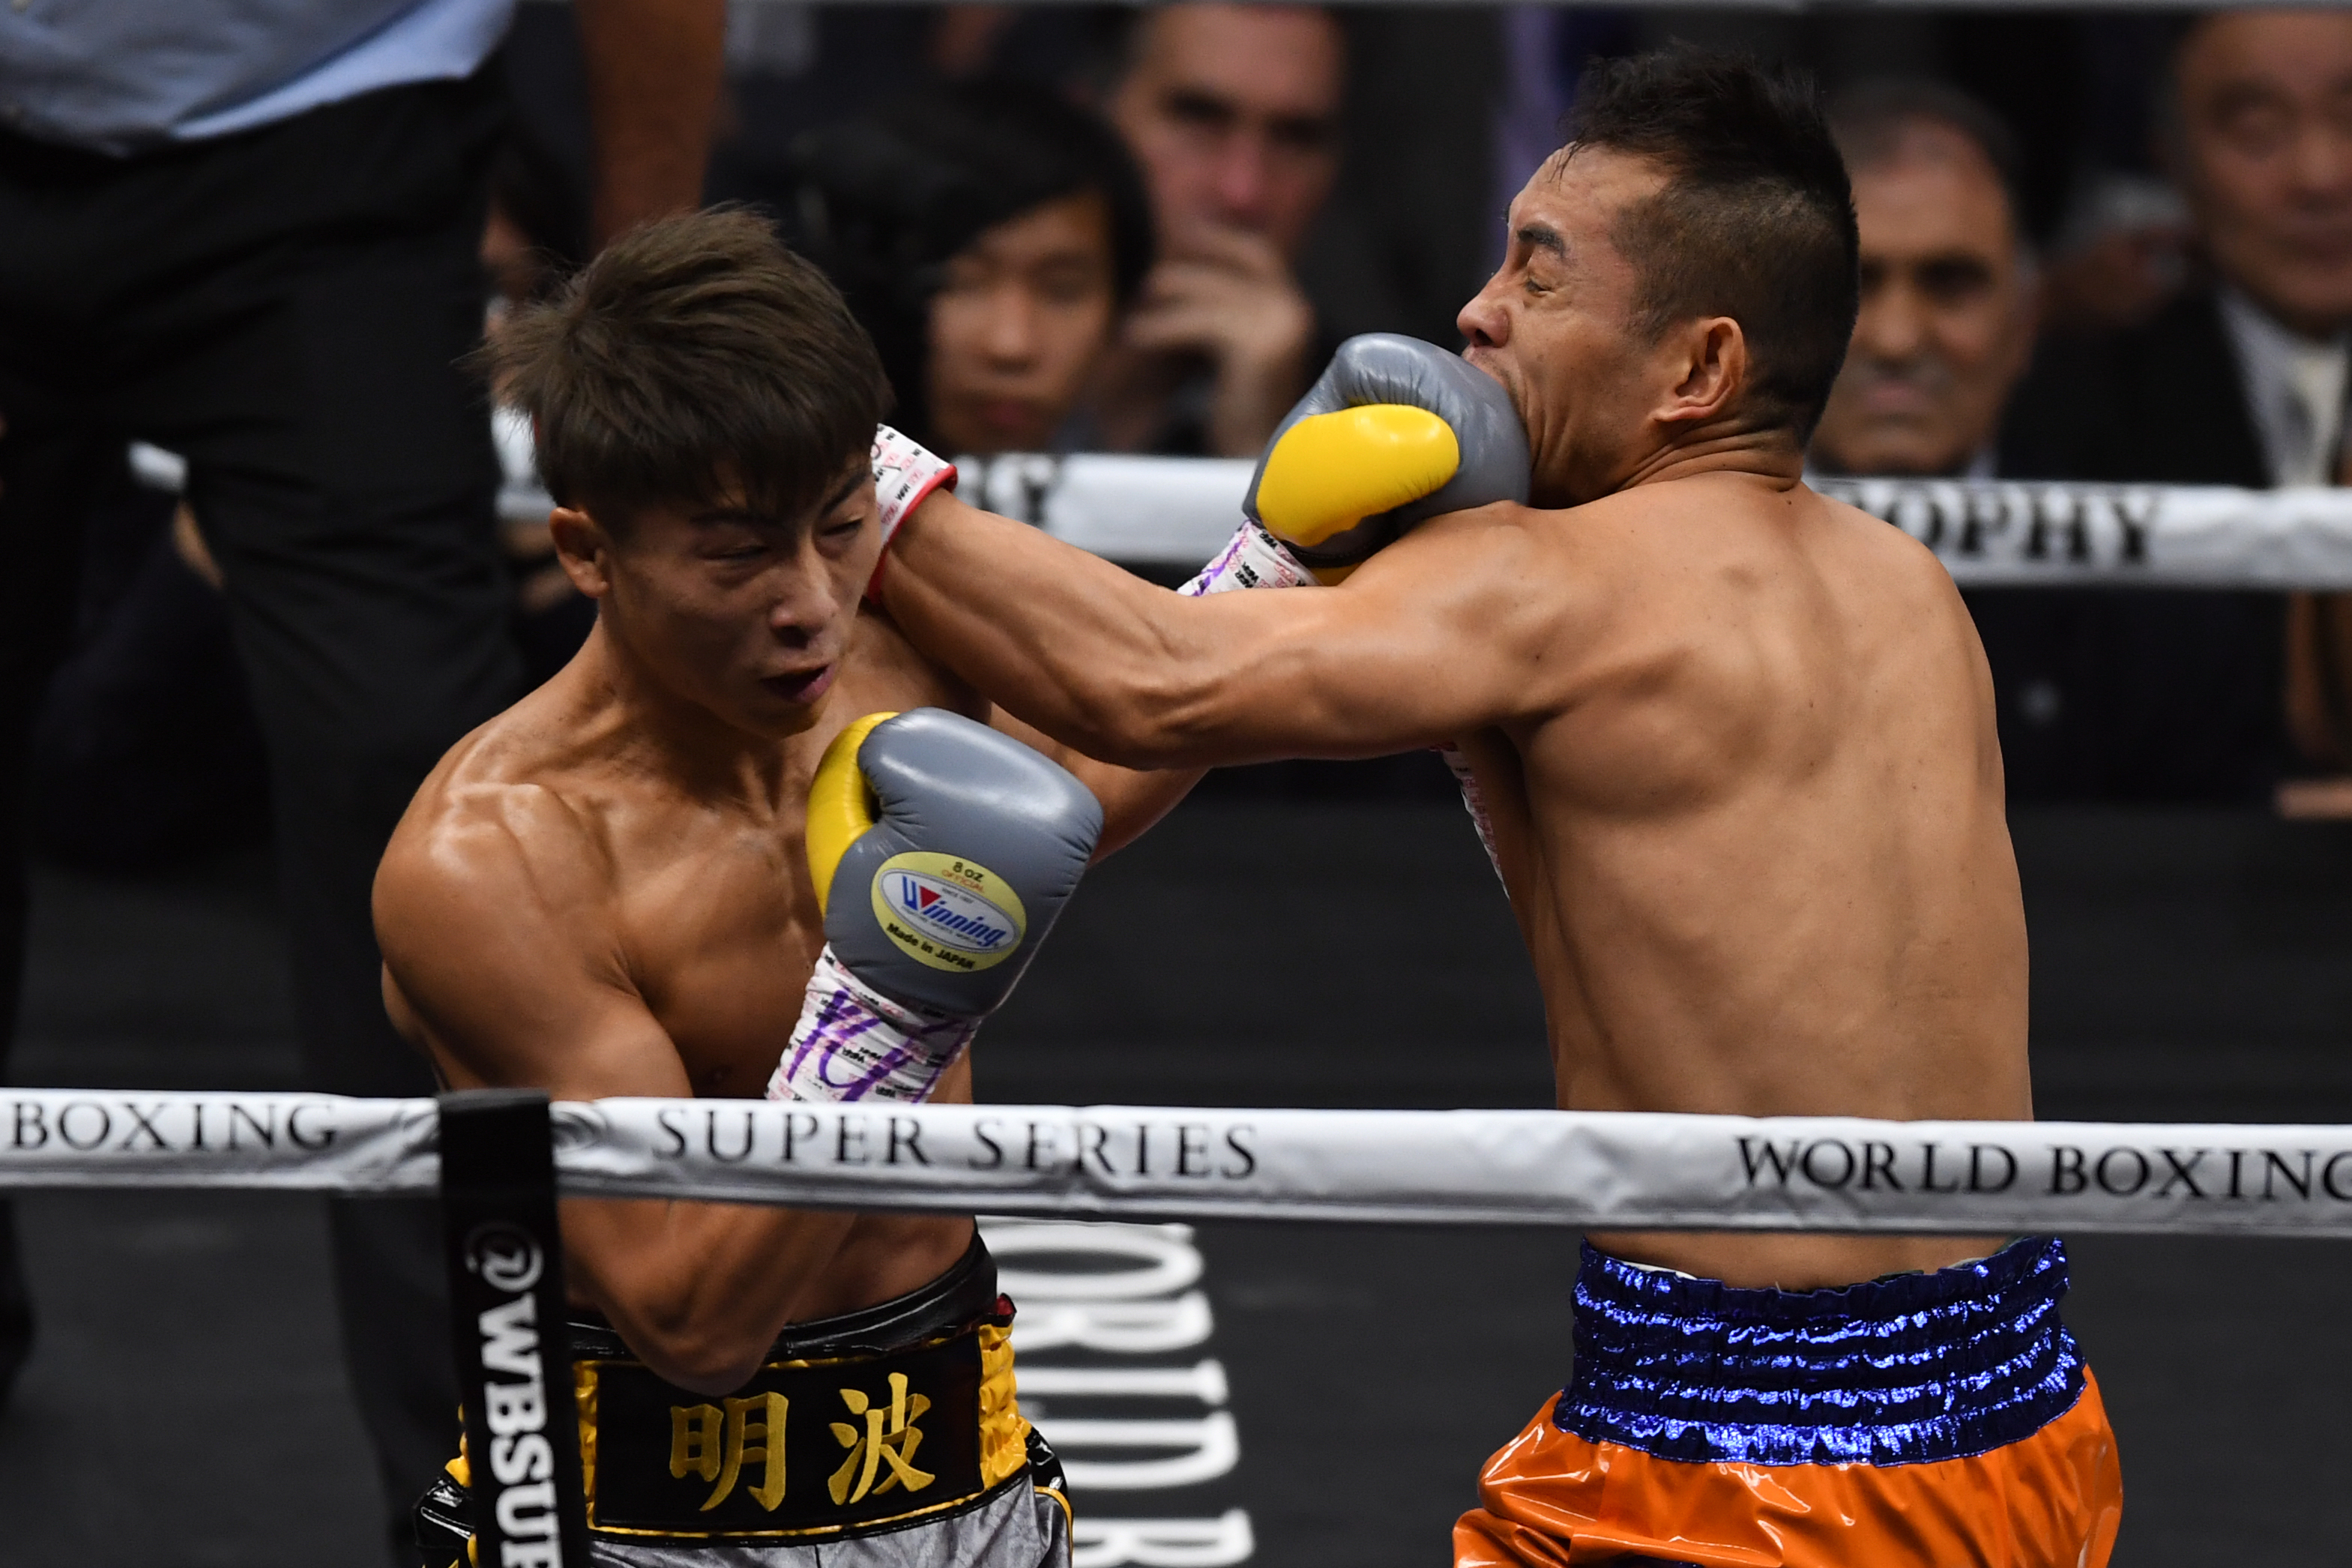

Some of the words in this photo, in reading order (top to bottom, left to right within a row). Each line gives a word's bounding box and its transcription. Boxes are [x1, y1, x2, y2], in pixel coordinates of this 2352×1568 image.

[1854, 489, 2160, 564] OPHY
[953, 861, 963, 873] 8
[887, 923, 919, 946] Made
[920, 941, 934, 954] in
[935, 949, 975, 970] JAPAN
[902, 875, 1007, 947] Winning
[10, 1100, 337, 1153] BOXING
[651, 1107, 931, 1167] SUPER
[967, 1118, 1256, 1180] SERIES
[1735, 1136, 2018, 1195] WORLD
[977, 1222, 1239, 1489] ORLD
[669, 1372, 935, 1513] 明波
